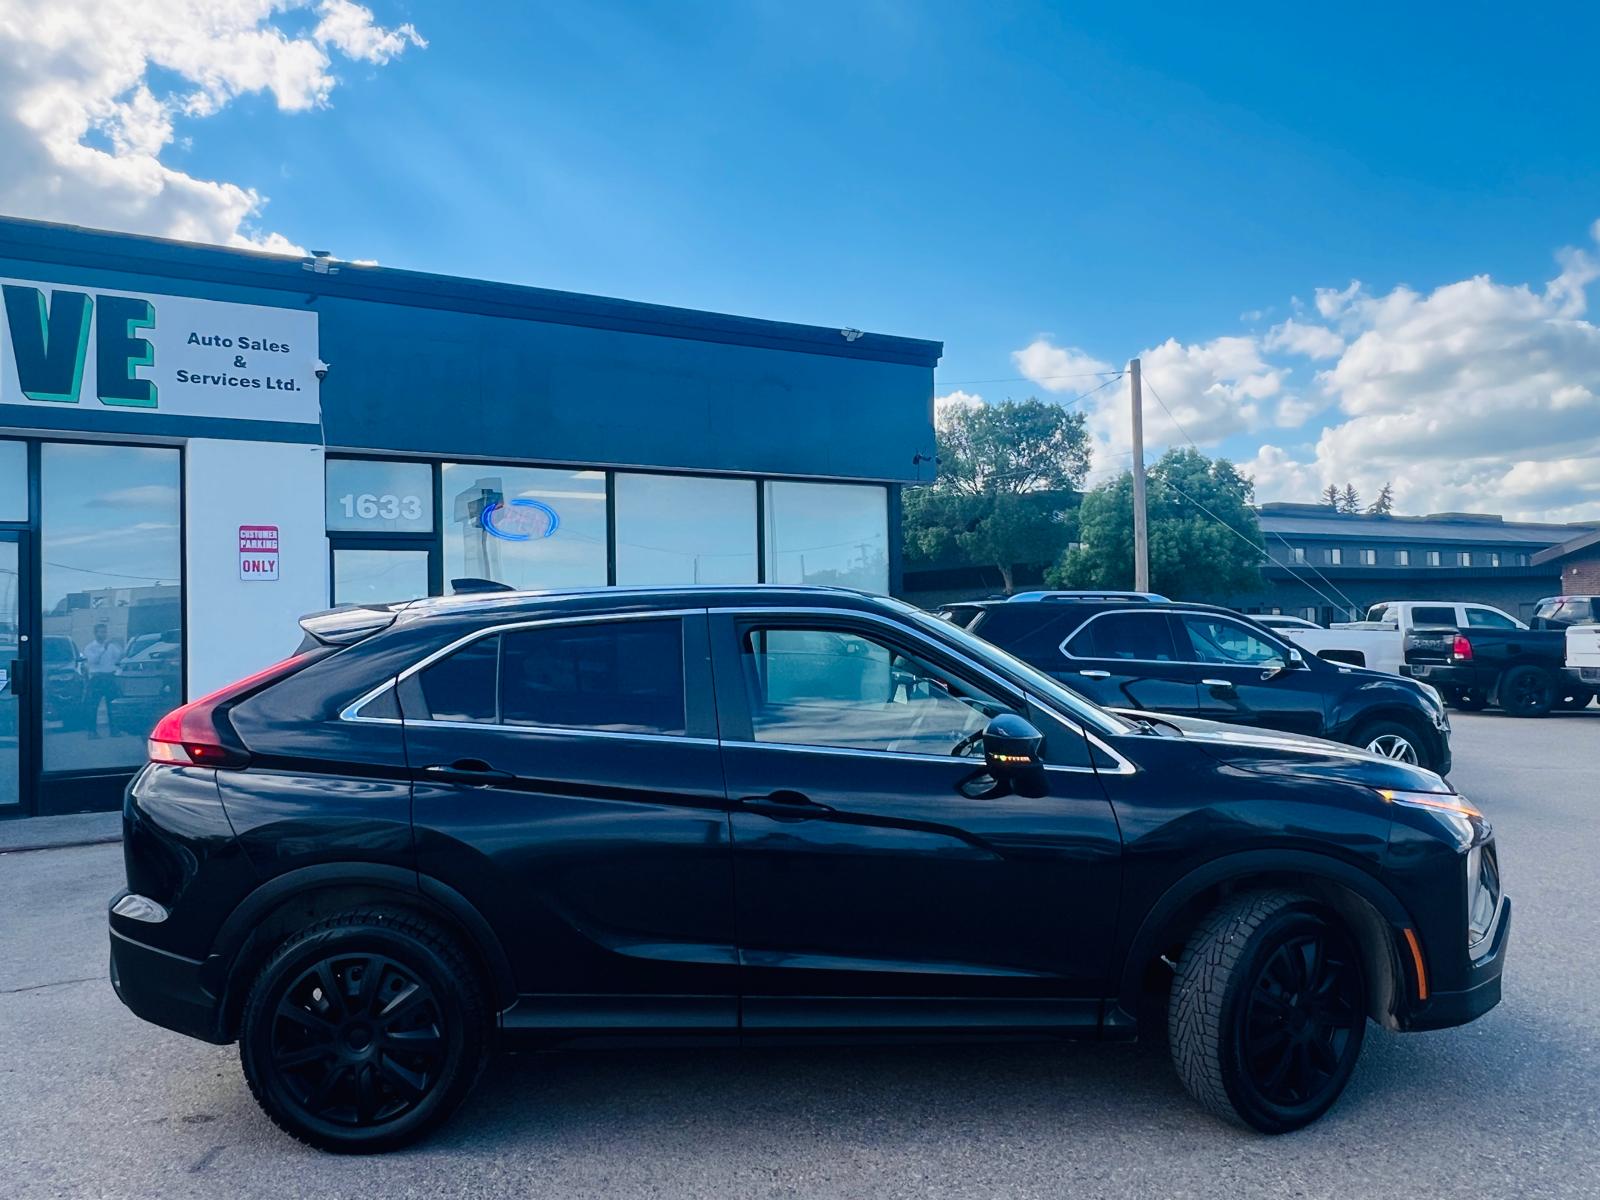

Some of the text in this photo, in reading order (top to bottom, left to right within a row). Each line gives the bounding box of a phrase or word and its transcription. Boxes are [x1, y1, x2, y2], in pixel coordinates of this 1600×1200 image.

[1, 284, 158, 408] VE
[187, 332, 290, 353] Auto Sales
[233, 355, 247, 368] &
[176, 369, 301, 391] Services Ltd.
[340, 494, 422, 520] 1633
[240, 540, 277, 548] PARKING
[242, 560, 275, 572] ONLY
